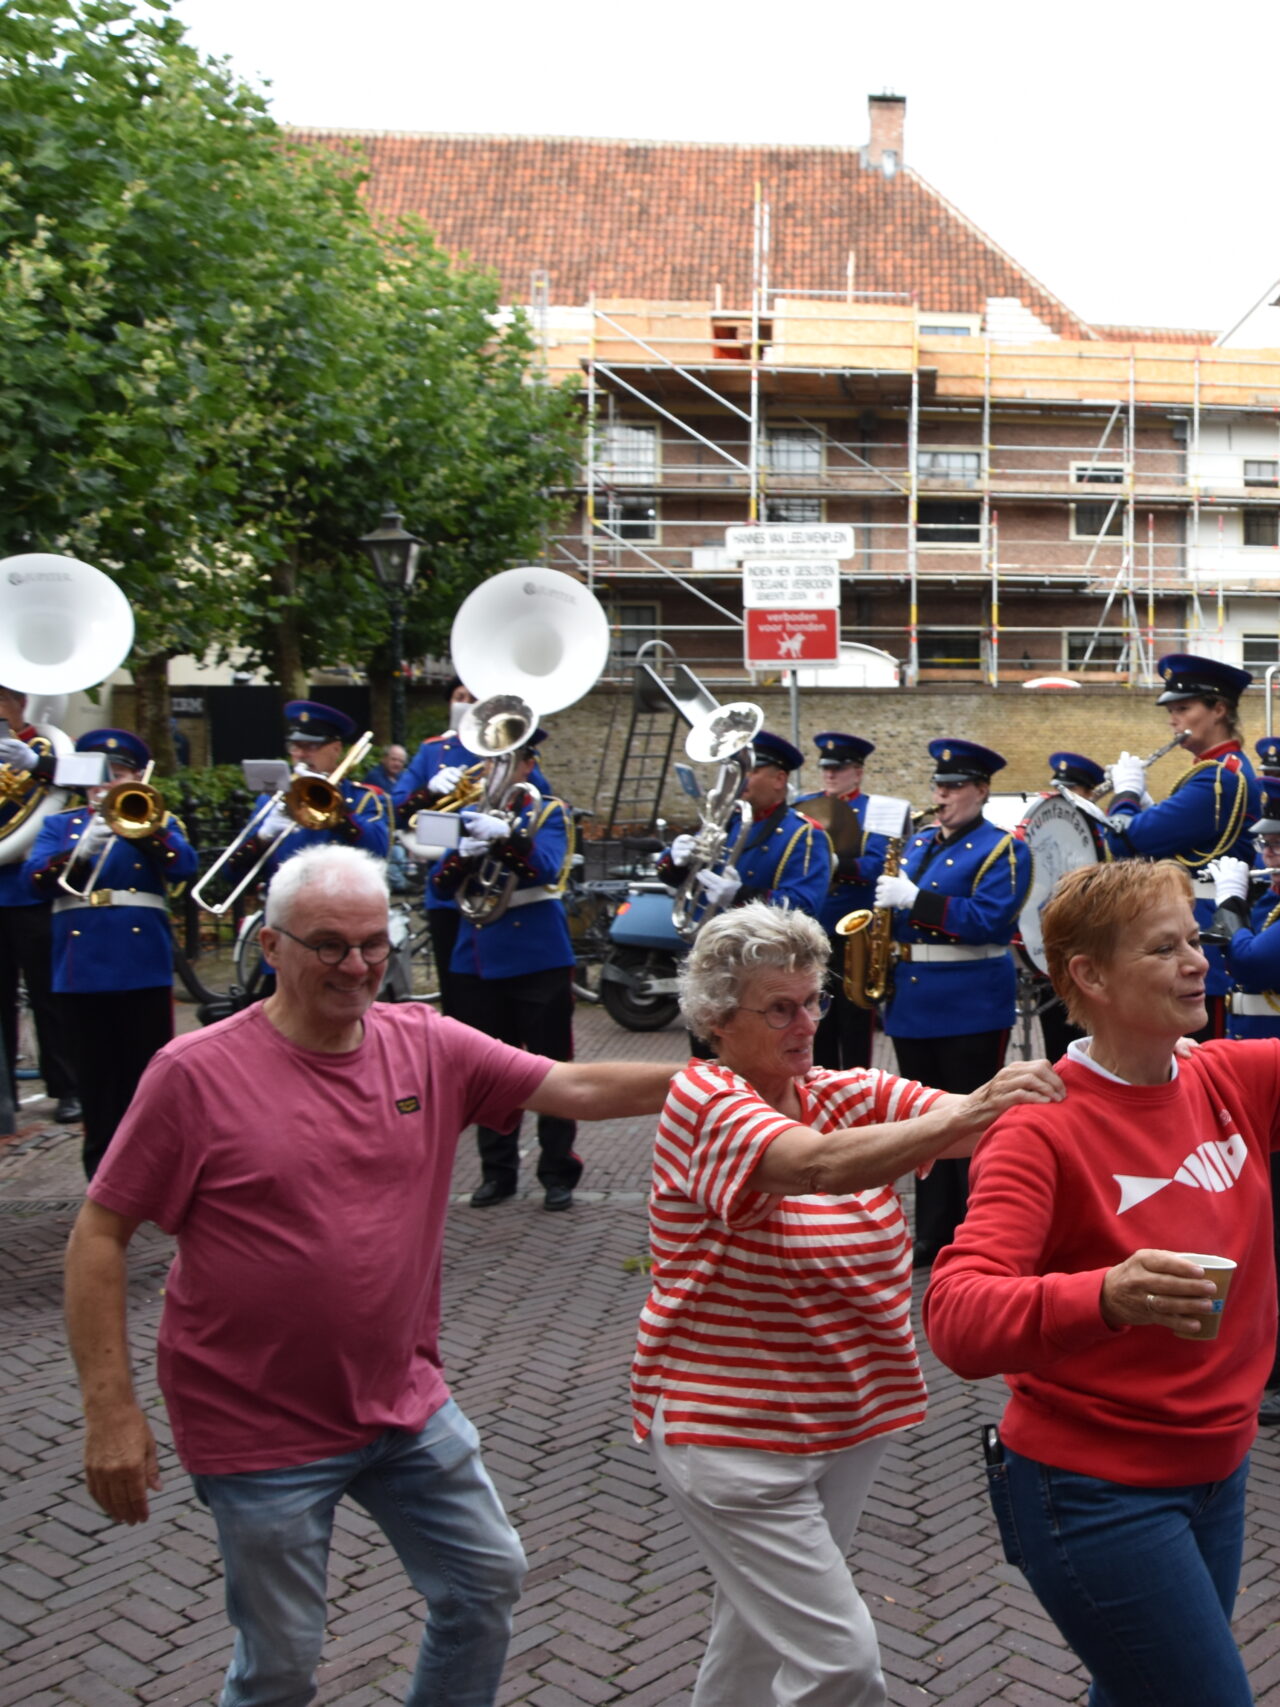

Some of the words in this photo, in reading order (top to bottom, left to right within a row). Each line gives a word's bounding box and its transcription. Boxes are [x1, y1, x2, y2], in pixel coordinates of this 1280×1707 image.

[766, 611, 818, 622] verboden
[758, 624, 783, 633] voor
[785, 622, 827, 633] honden
